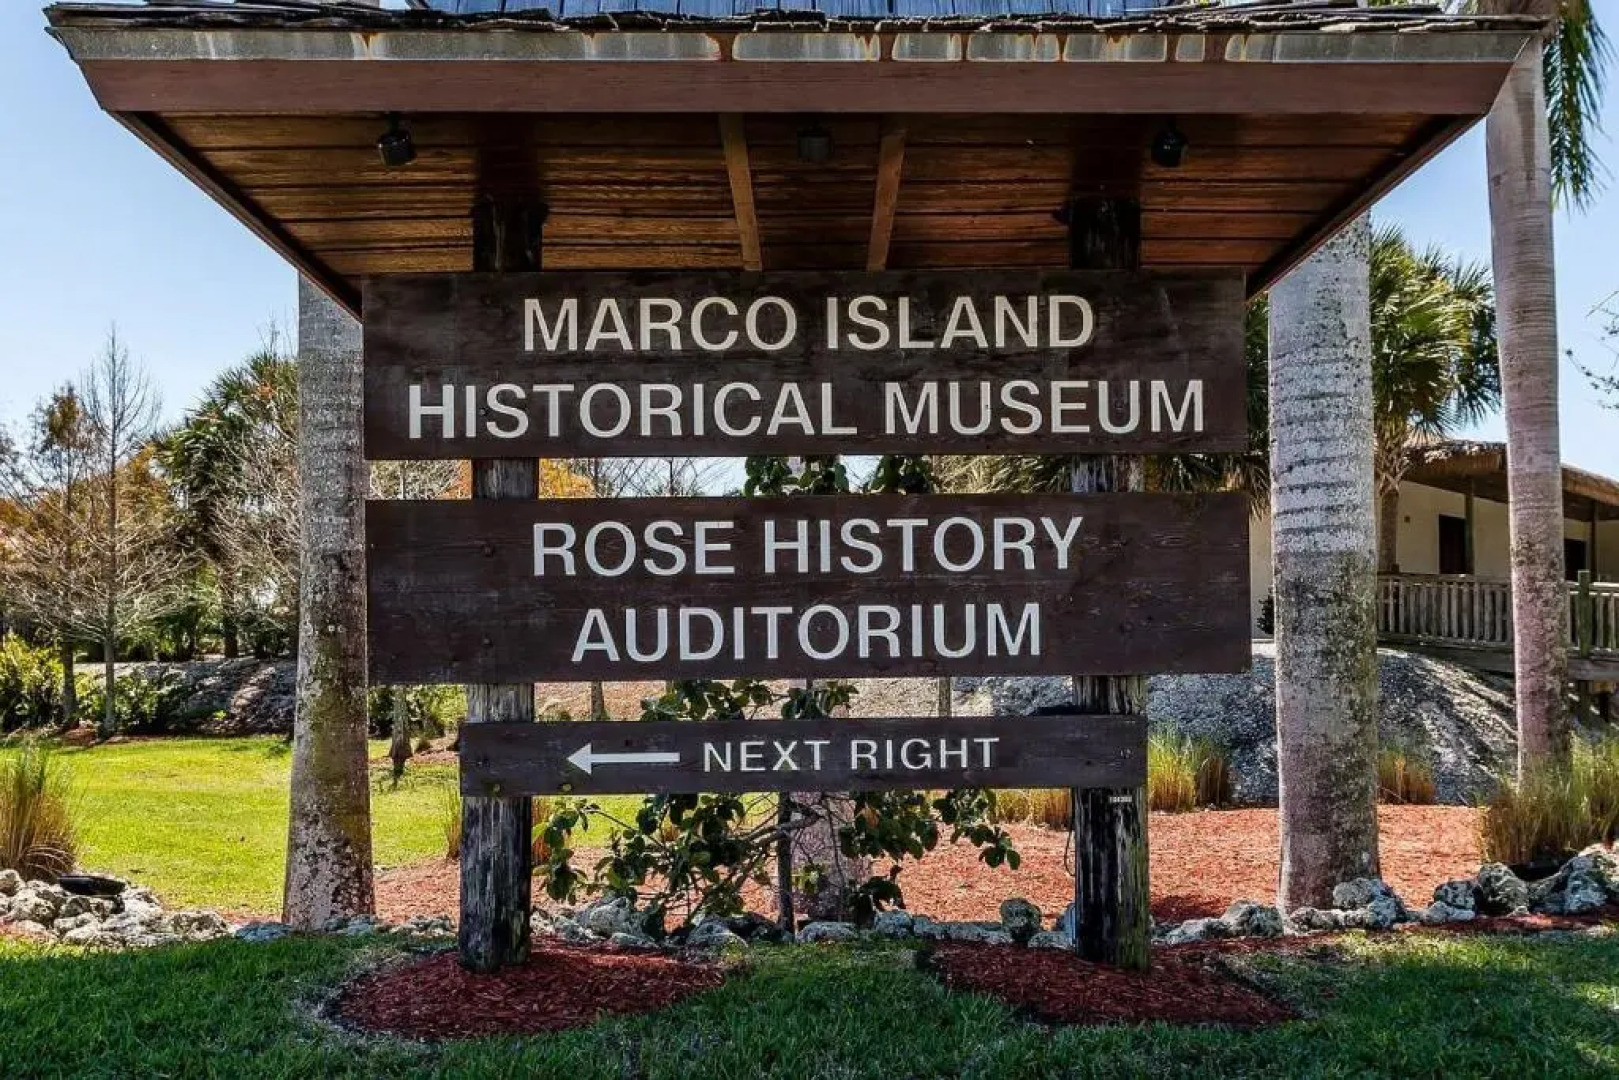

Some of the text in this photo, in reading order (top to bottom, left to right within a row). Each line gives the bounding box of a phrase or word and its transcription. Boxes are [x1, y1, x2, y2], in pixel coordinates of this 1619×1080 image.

[525, 296, 1092, 351] MARCO ISLAND
[410, 380, 1203, 438] HISTORICAL MUSEUM
[534, 517, 1082, 576] ROSE HISTORY
[572, 603, 1039, 661] AUDITORIUM
[704, 738, 999, 772] NEXT RIGHT
